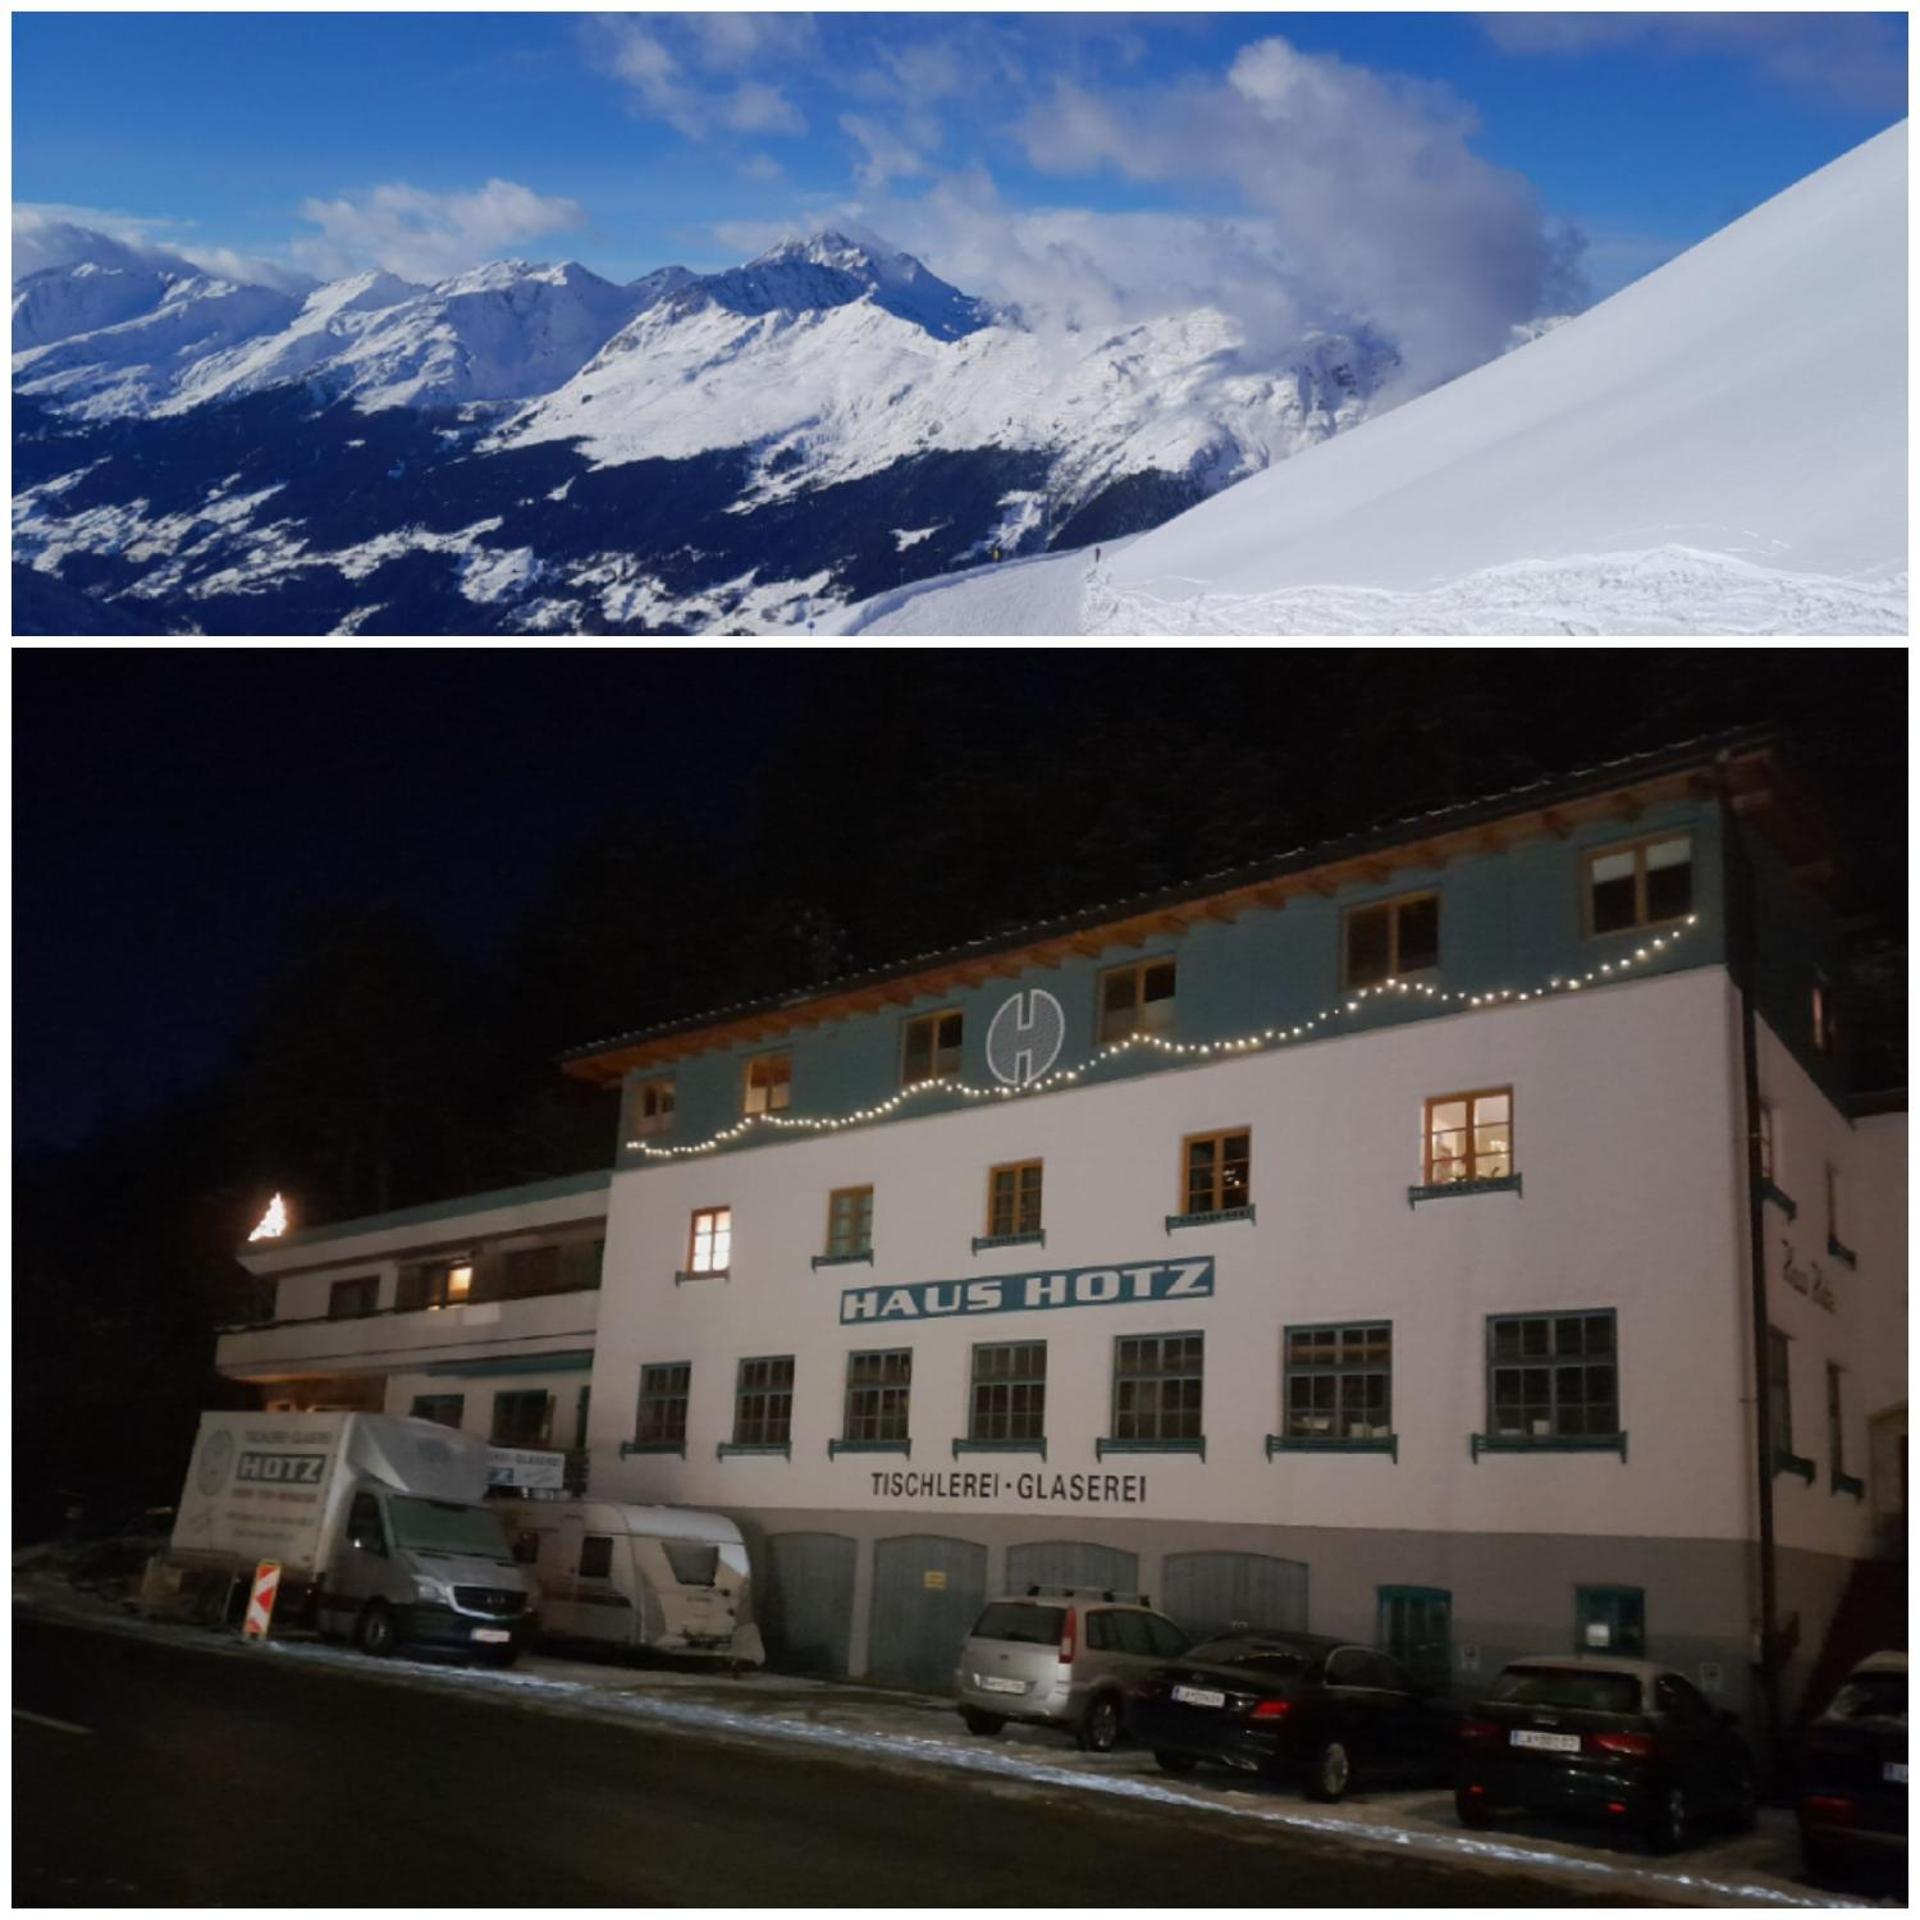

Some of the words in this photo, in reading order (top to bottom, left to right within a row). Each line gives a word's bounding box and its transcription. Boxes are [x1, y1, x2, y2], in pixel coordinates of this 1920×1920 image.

[843, 1280, 1003, 1321] HAUS
[1025, 1262, 1212, 1307] HOTZ
[240, 1455, 322, 1482] HOTZ
[872, 1472, 999, 1498] TISCHLEREI
[1017, 1473, 1147, 1502] GLASEREI
